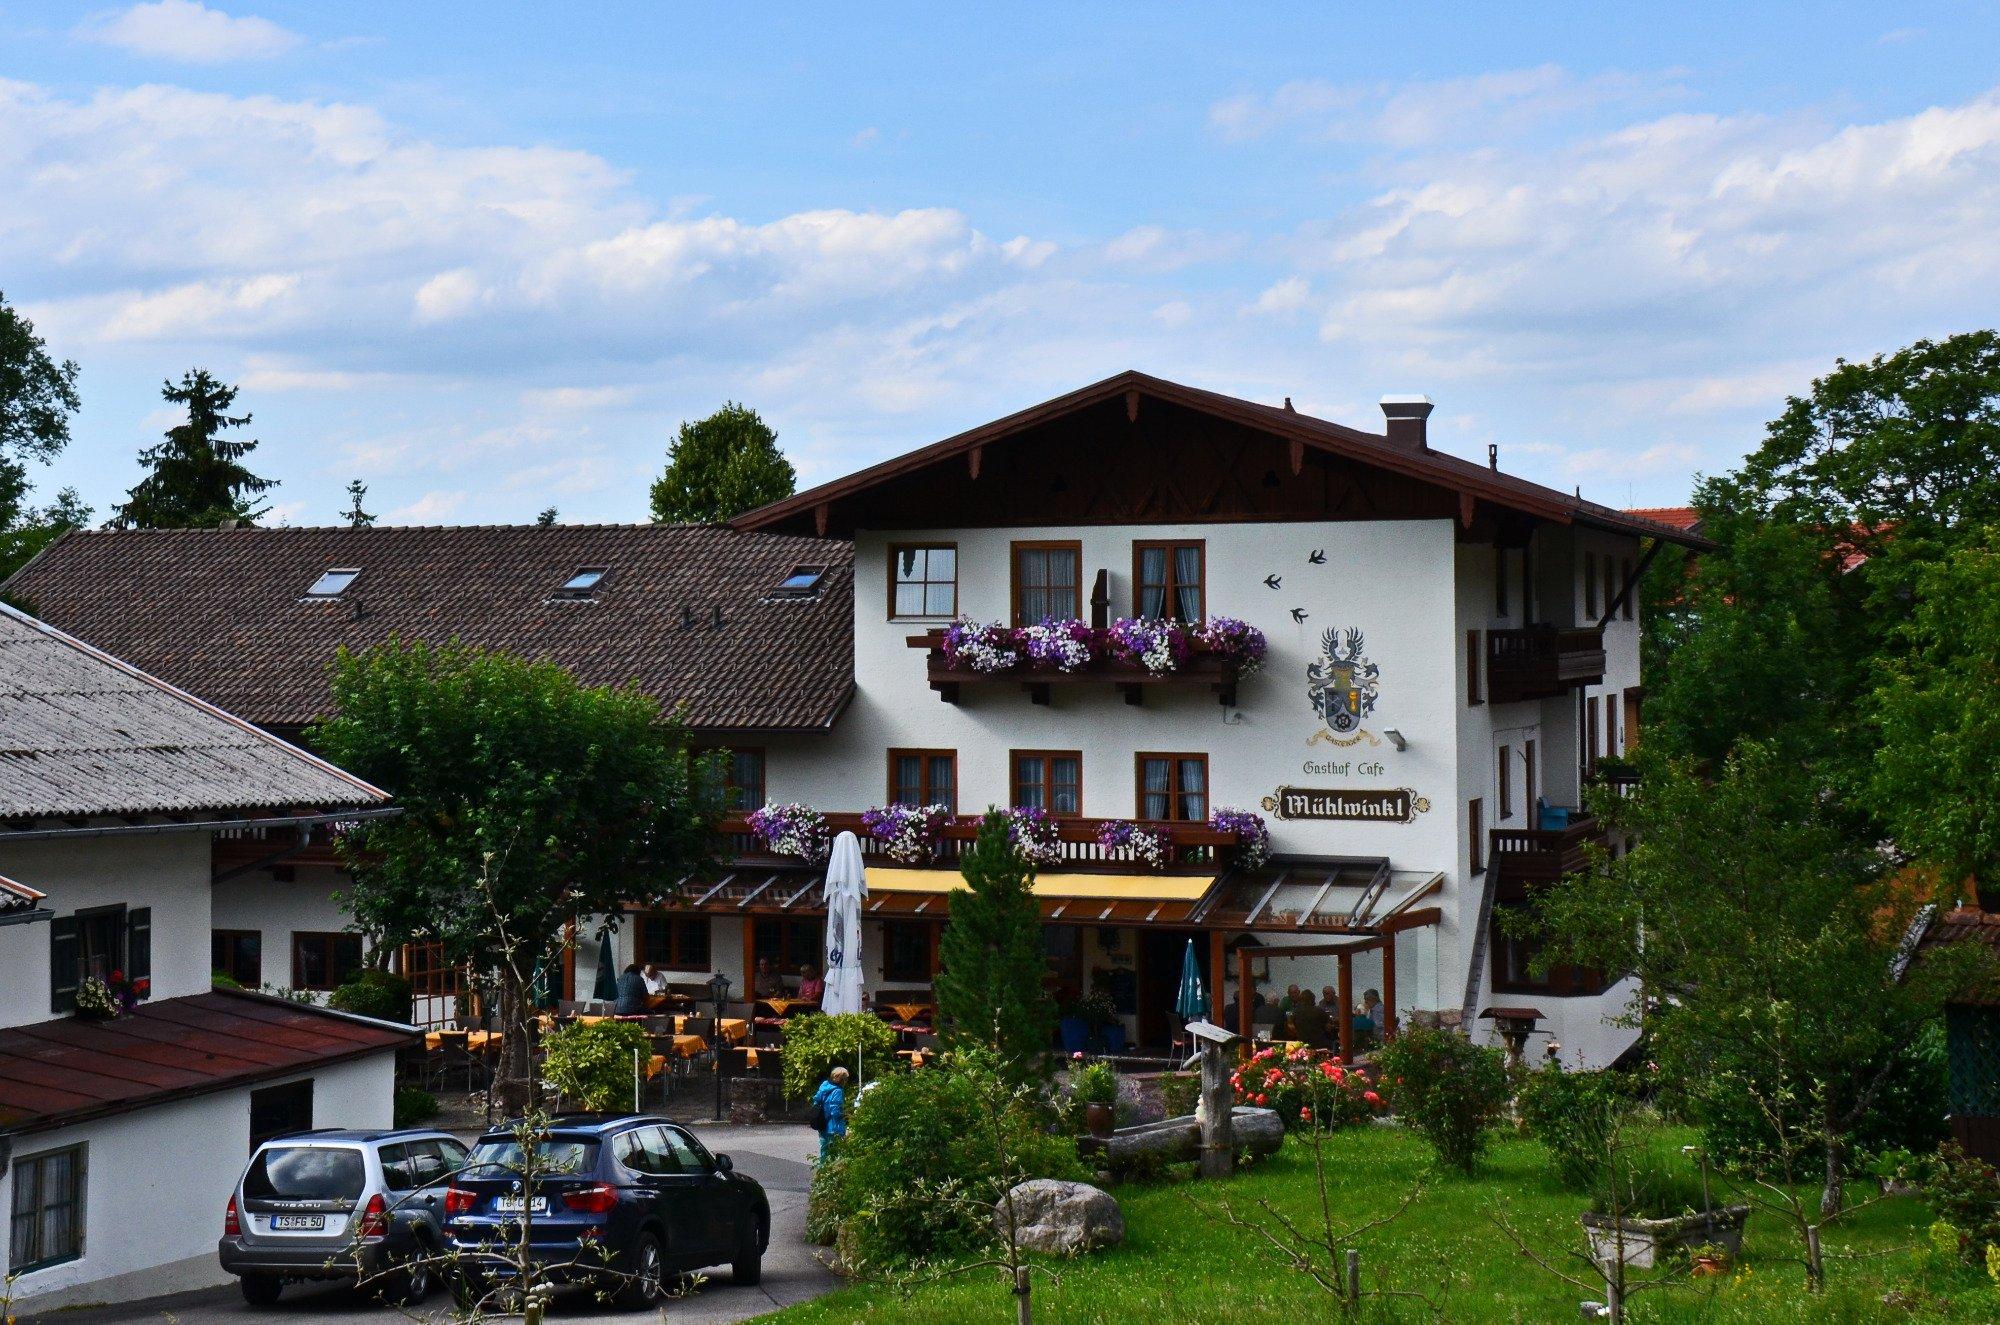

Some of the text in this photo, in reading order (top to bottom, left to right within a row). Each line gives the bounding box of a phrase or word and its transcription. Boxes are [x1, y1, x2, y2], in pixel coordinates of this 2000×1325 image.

[1302, 760, 1385, 777] Gasthof Cafe
[1285, 795, 1403, 817] Mühlwinkl
[310, 1216, 322, 1227] 50
